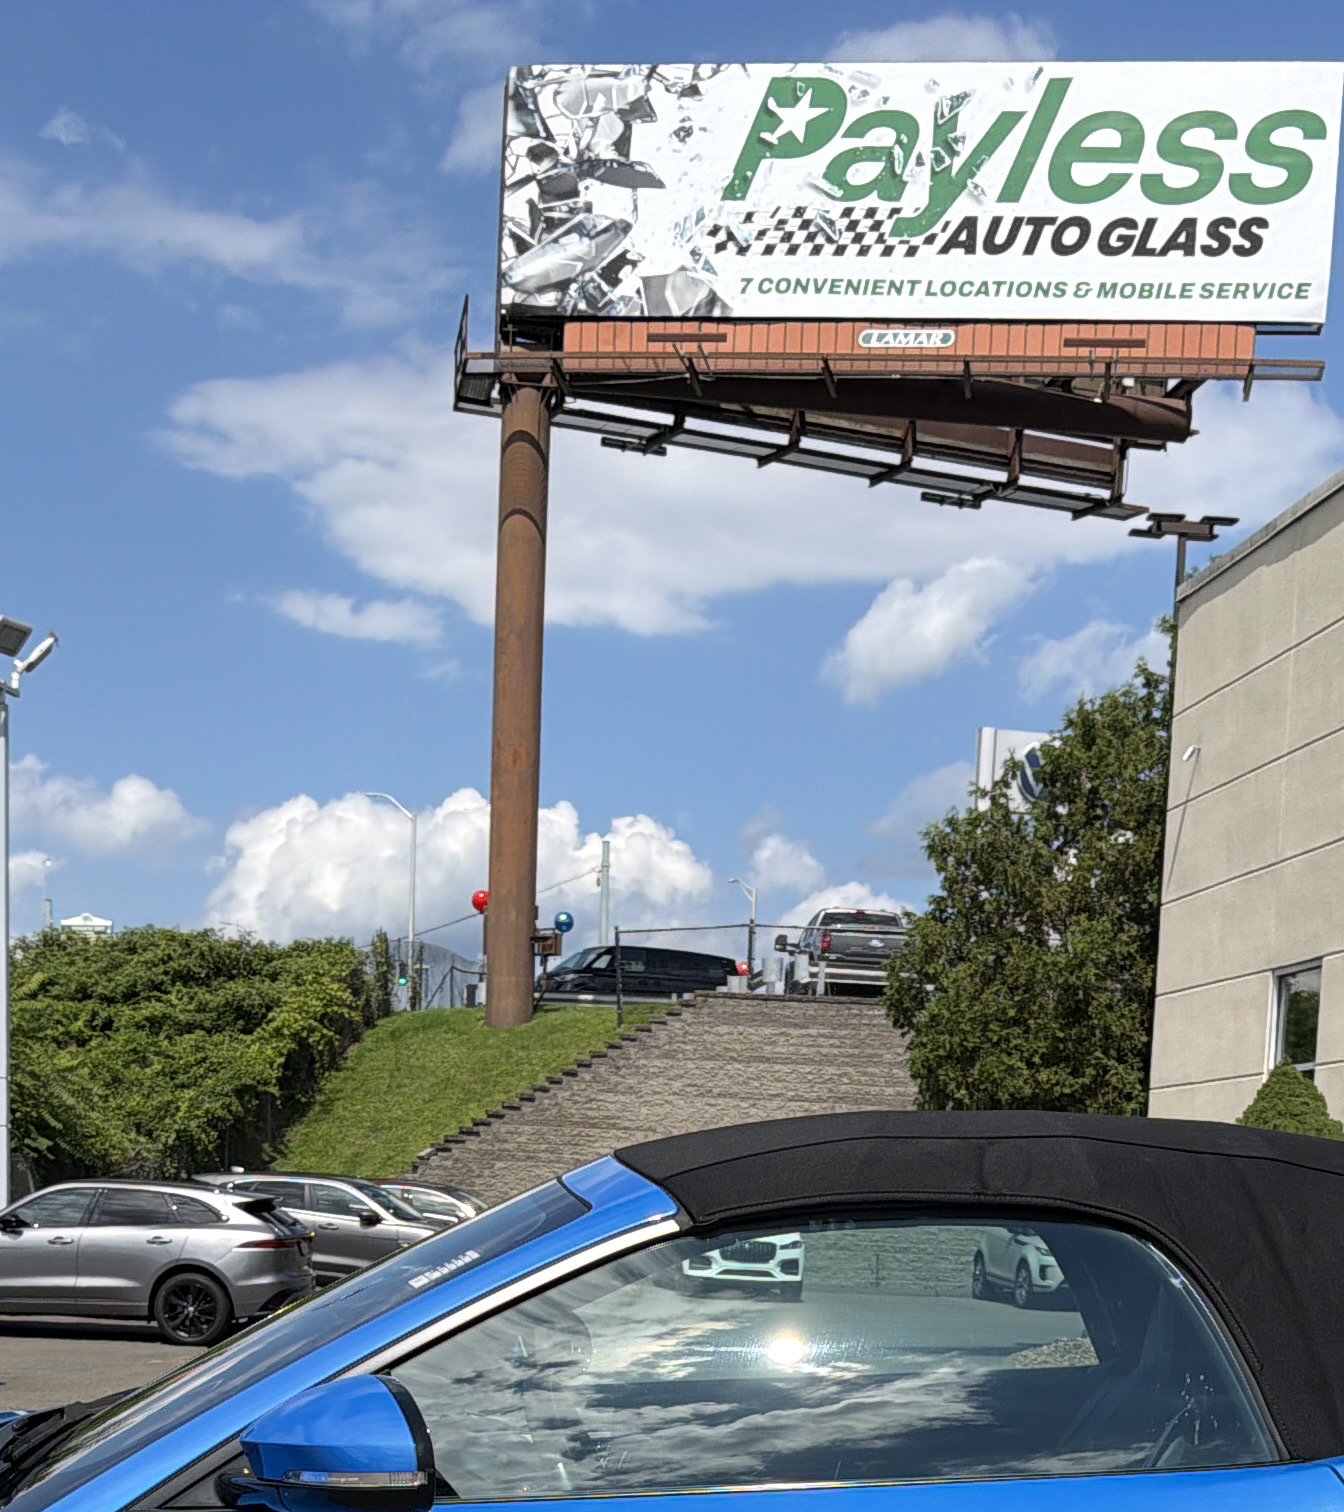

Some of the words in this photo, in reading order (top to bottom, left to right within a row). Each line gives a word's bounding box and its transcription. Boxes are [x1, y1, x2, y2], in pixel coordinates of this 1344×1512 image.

[720, 77, 1327, 238] Payless
[936, 215, 1092, 257] AUTO
[1097, 216, 1270, 257] GLASS
[739, 278, 754, 295] 7
[757, 277, 923, 296] CONVENIENT
[924, 280, 1069, 298] LOCATIONS
[1072, 281, 1094, 298] &
[1096, 282, 1196, 299] MOBILE
[1199, 283, 1313, 300] SERVICE
[869, 330, 945, 346] LAMAR
